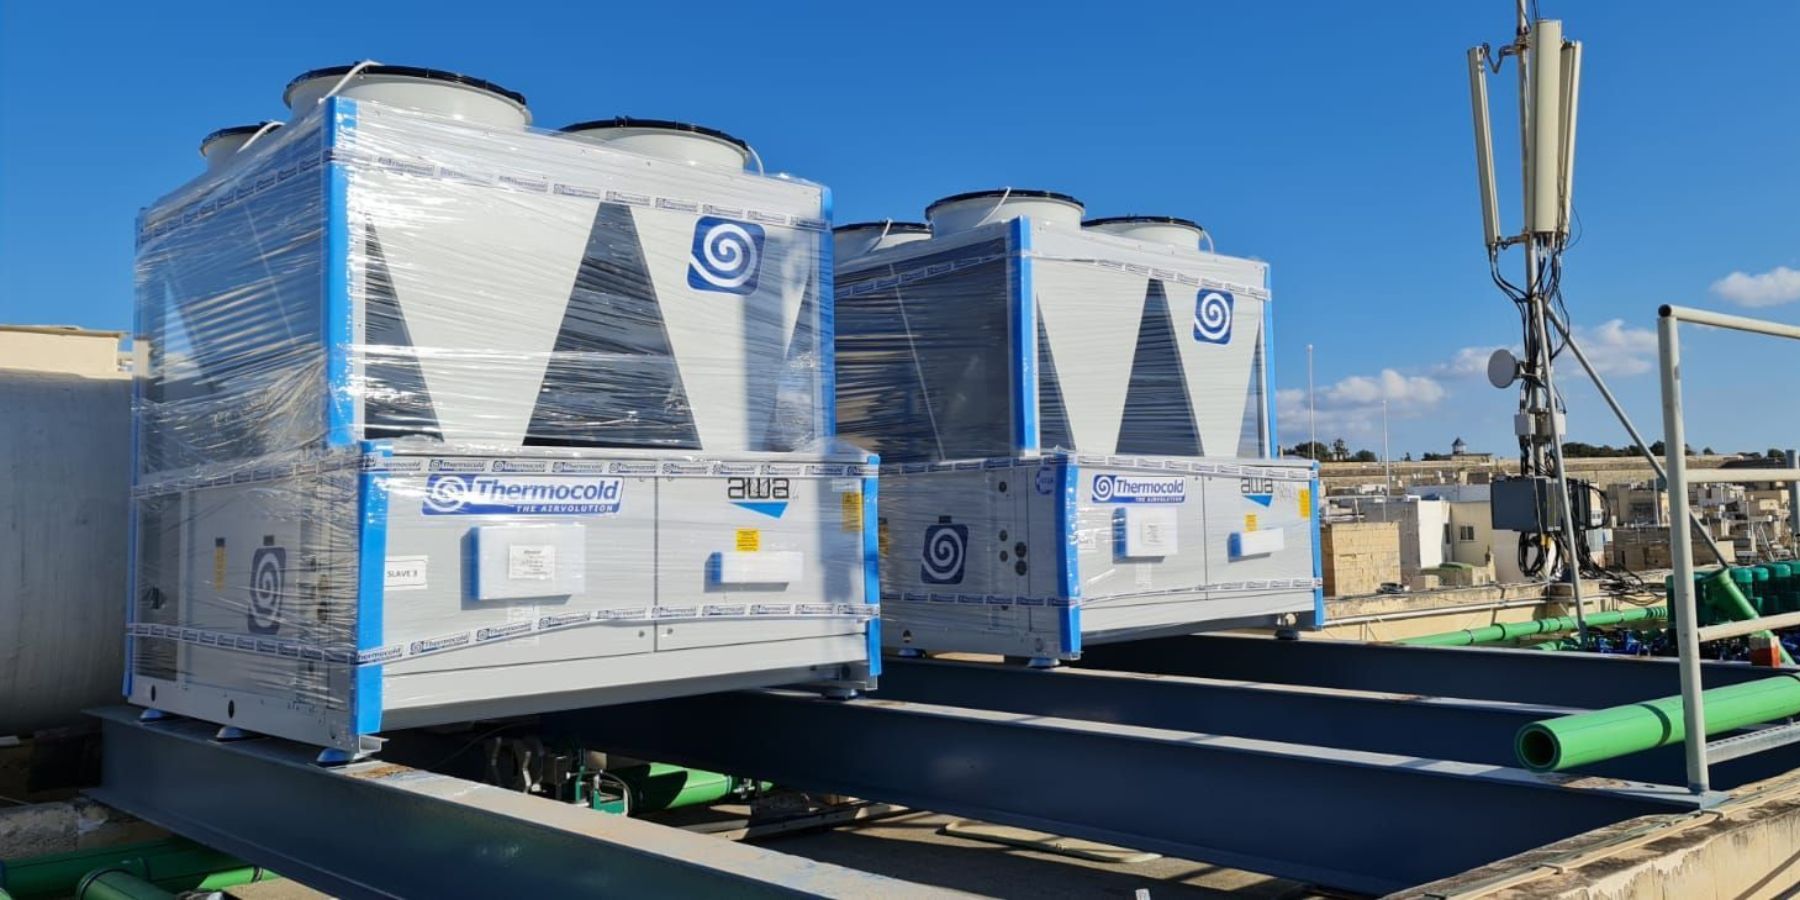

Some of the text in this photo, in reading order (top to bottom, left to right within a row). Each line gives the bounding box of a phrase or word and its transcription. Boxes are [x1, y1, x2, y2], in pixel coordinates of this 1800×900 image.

[476, 480, 619, 500] Thermocold
[1117, 479, 1184, 494] Thermocold
[517, 505, 613, 513] THE AIRVOLUTION
